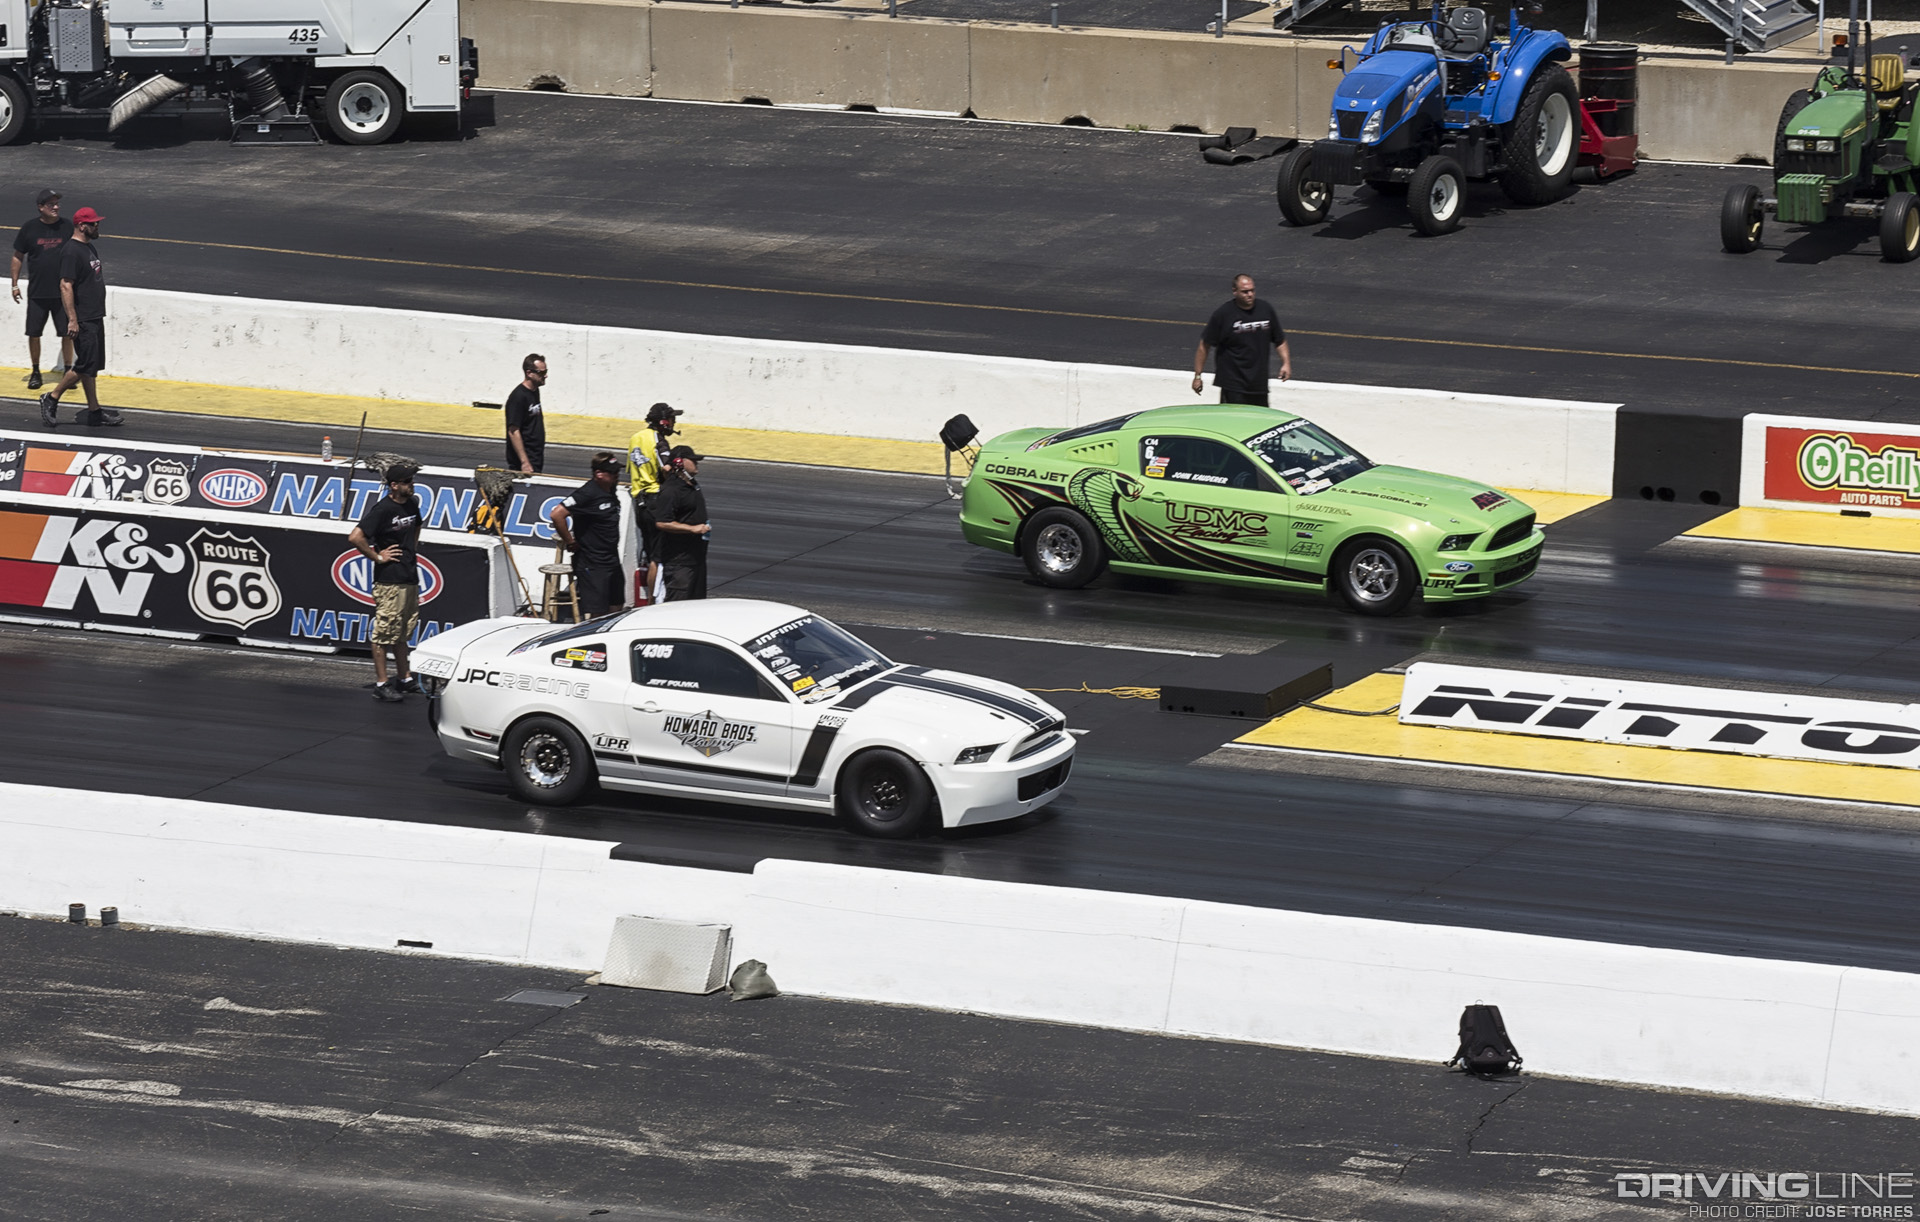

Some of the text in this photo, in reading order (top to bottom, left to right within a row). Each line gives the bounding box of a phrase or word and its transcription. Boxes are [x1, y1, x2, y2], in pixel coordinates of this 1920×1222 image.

[288, 28, 319, 42] 435
[1246, 430, 1278, 449] FORD
[1276, 419, 1310, 434] RACING
[1144, 446, 1155, 459] 6
[154, 464, 183, 475] ROUTE
[985, 463, 1069, 483] COBRA JET
[1171, 471, 1192, 480] JOHN
[153, 477, 183, 498] 66
[208, 476, 257, 500] NHRA
[1350, 490, 1379, 498] SUPER
[1380, 494, 1410, 504] COBRA
[1840, 492, 1902, 506] AUTO PARTS
[269, 472, 573, 541] NATONLS
[1165, 501, 1269, 534] UDMC
[1165, 525, 1242, 544] Racing
[202, 542, 260, 562] ROUTE
[1449, 563, 1470, 572] Ford
[206, 569, 268, 612] 66
[1423, 578, 1456, 588] UPR
[755, 617, 813, 646] INFINITY
[641, 644, 675, 659] 4305
[646, 678, 668, 686] JEFF
[663, 716, 757, 742] HOWARD BROS.
[596, 736, 629, 749] UPR
[681, 734, 736, 752] Racing
